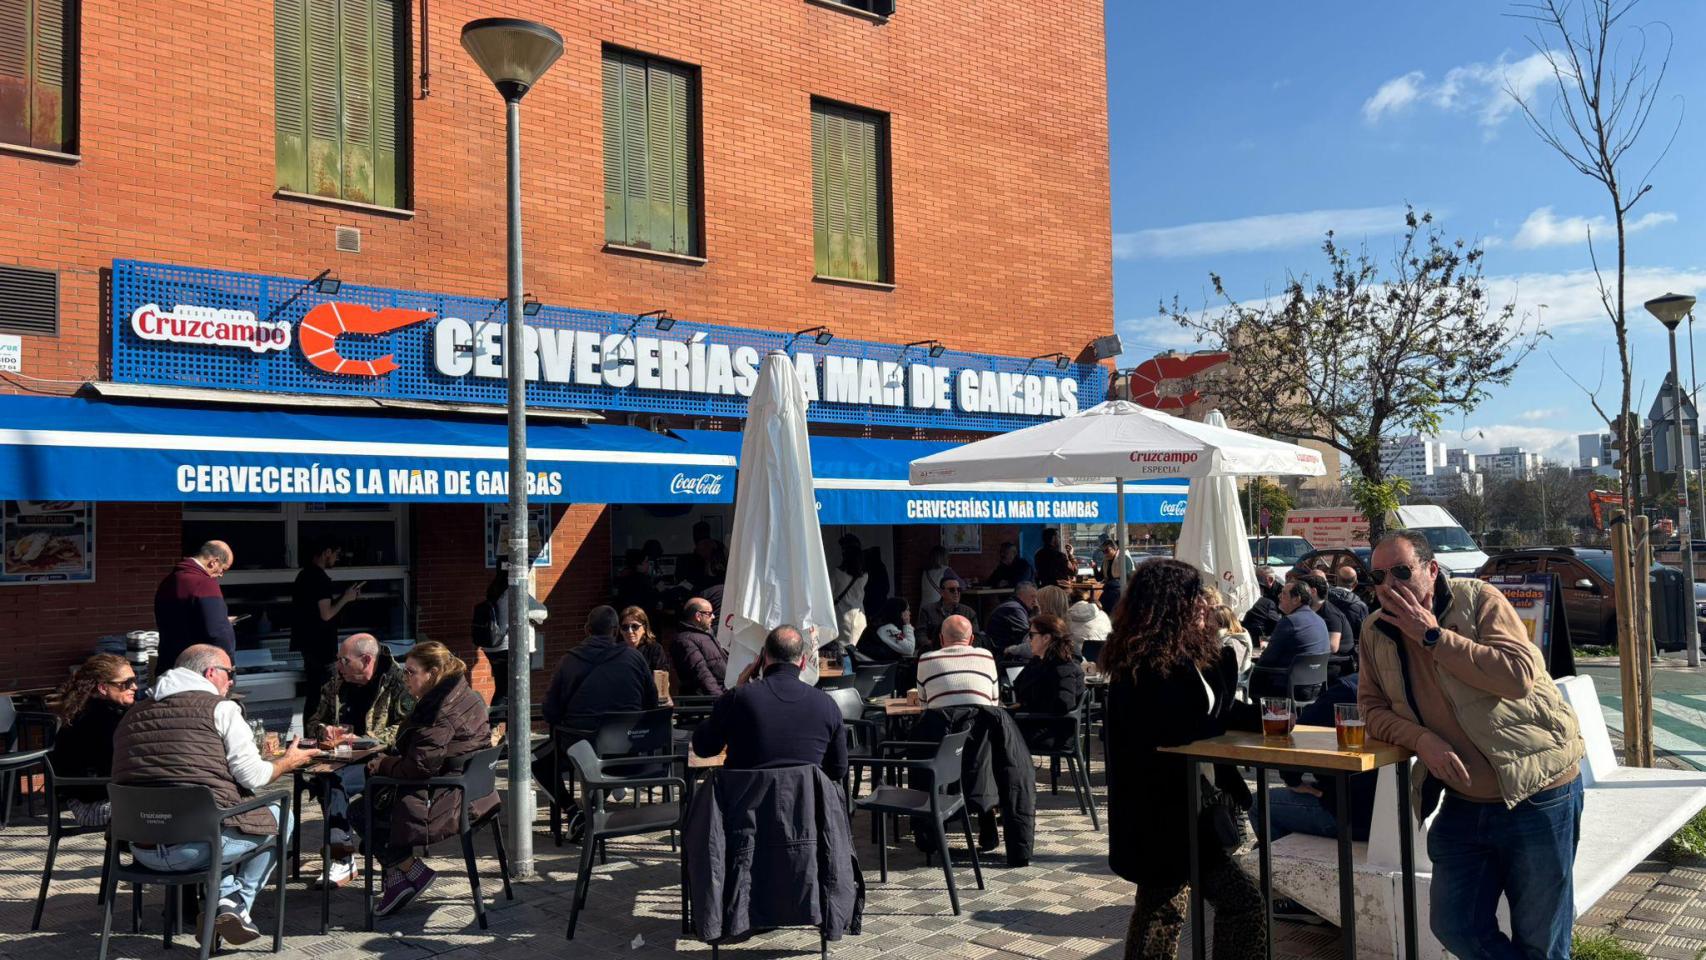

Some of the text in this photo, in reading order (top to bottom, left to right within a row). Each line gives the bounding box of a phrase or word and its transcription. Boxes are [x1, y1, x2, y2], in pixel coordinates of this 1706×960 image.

[138, 310, 286, 347] Cruzcampo
[434, 317, 759, 397] CERVECERÍAS
[823, 354, 904, 406] MAR
[908, 363, 951, 410] DE
[956, 368, 1078, 417] GAMBAS
[1129, 451, 1198, 464] Cruzcampo
[177, 463, 351, 494] CERVECERÍAS
[355, 467, 384, 495] LA
[389, 469, 439, 495] MAR
[444, 470, 471, 495] DE
[1142, 465, 1181, 474] ESPECIAL
[670, 472, 724, 495] Coca-Cola
[907, 497, 1099, 519] CERVECERÍAS LA MAR DE GAMBAS
[1503, 589, 1544, 598] Heladas
